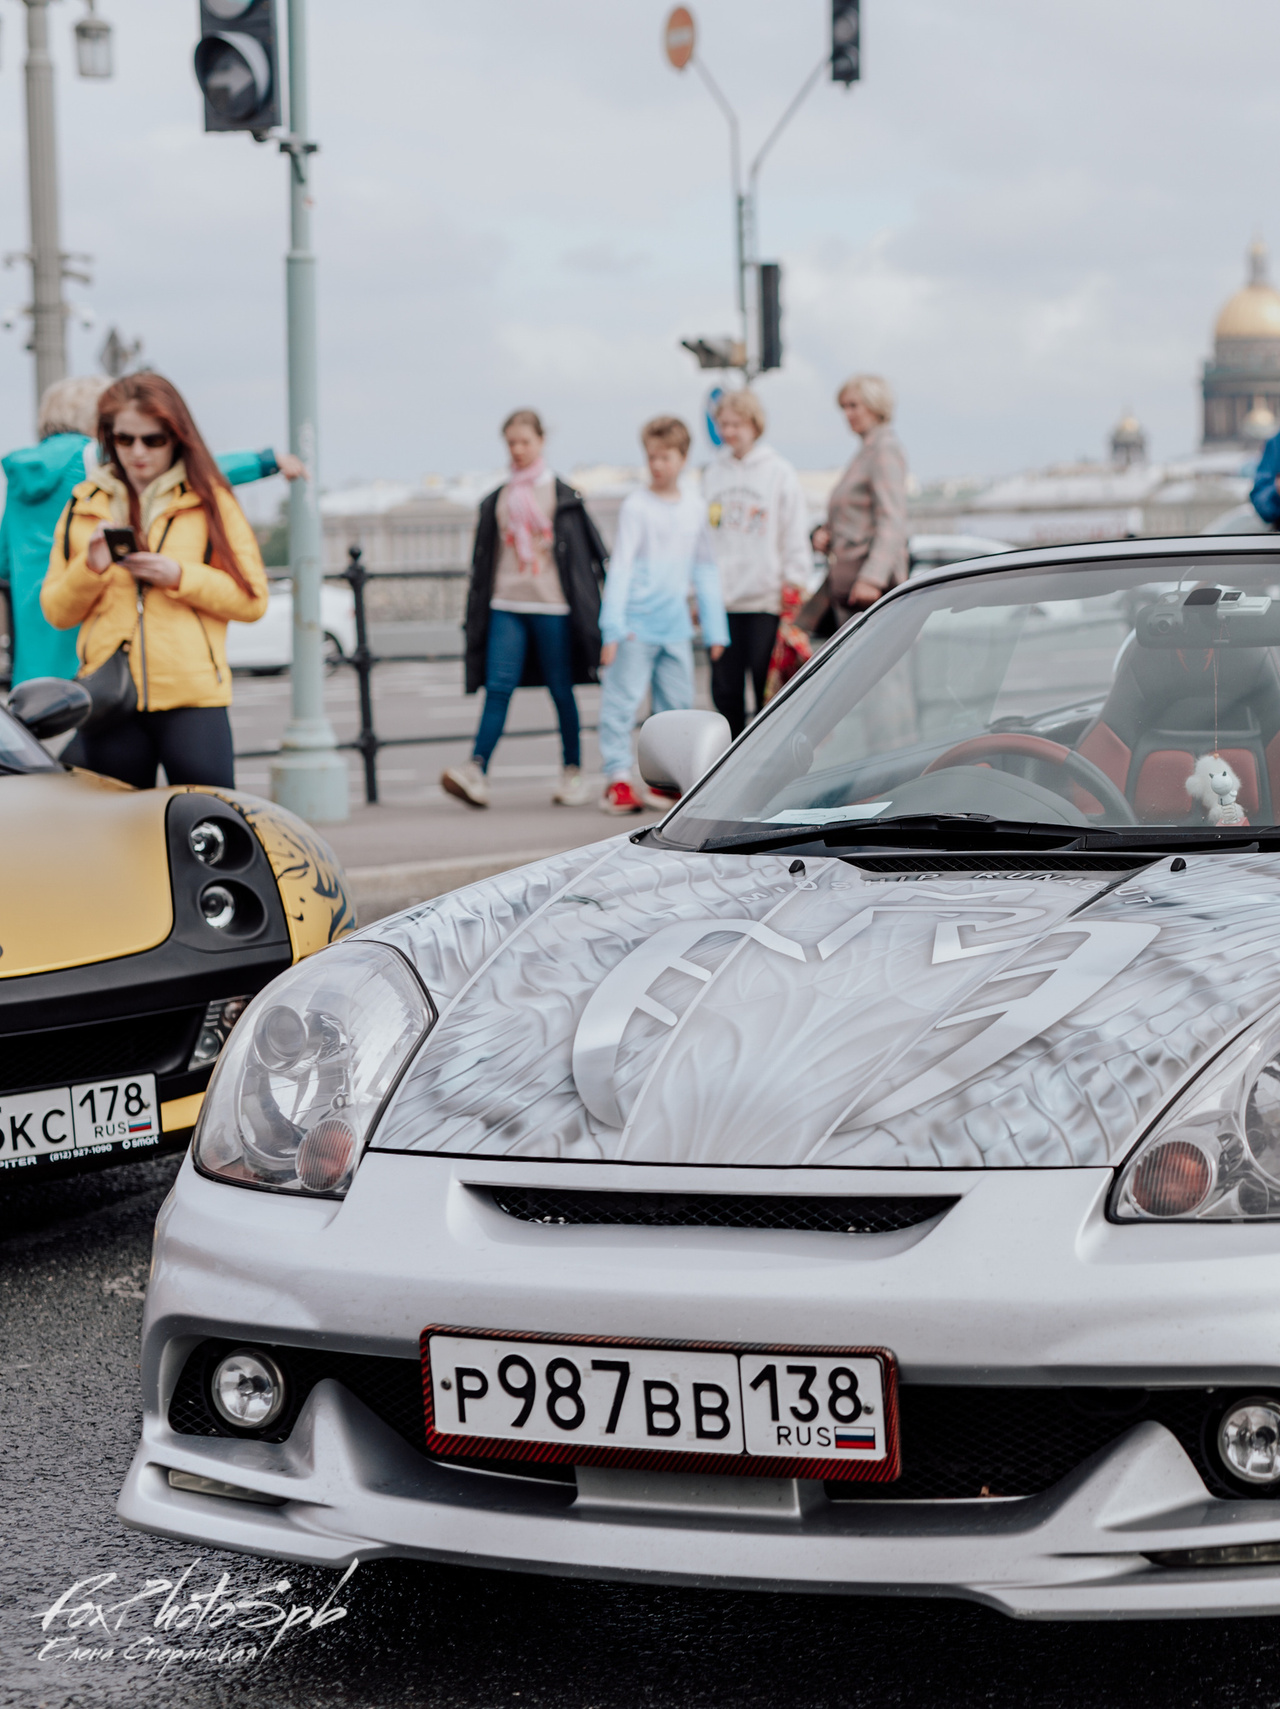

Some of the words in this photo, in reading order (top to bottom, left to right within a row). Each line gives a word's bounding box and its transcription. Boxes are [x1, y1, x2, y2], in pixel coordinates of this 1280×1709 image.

[737, 872, 941, 904] MIDSHIP
[973, 871, 1155, 905] RUNABUT
[0, 1107, 68, 1152] KC
[79, 1082, 144, 1124] 178
[94, 1121, 127, 1139] RUS
[50, 1149, 72, 1162] (812)
[132, 1135, 159, 1148] smart
[749, 1364, 863, 1424] 138
[776, 1425, 832, 1447] RUS
